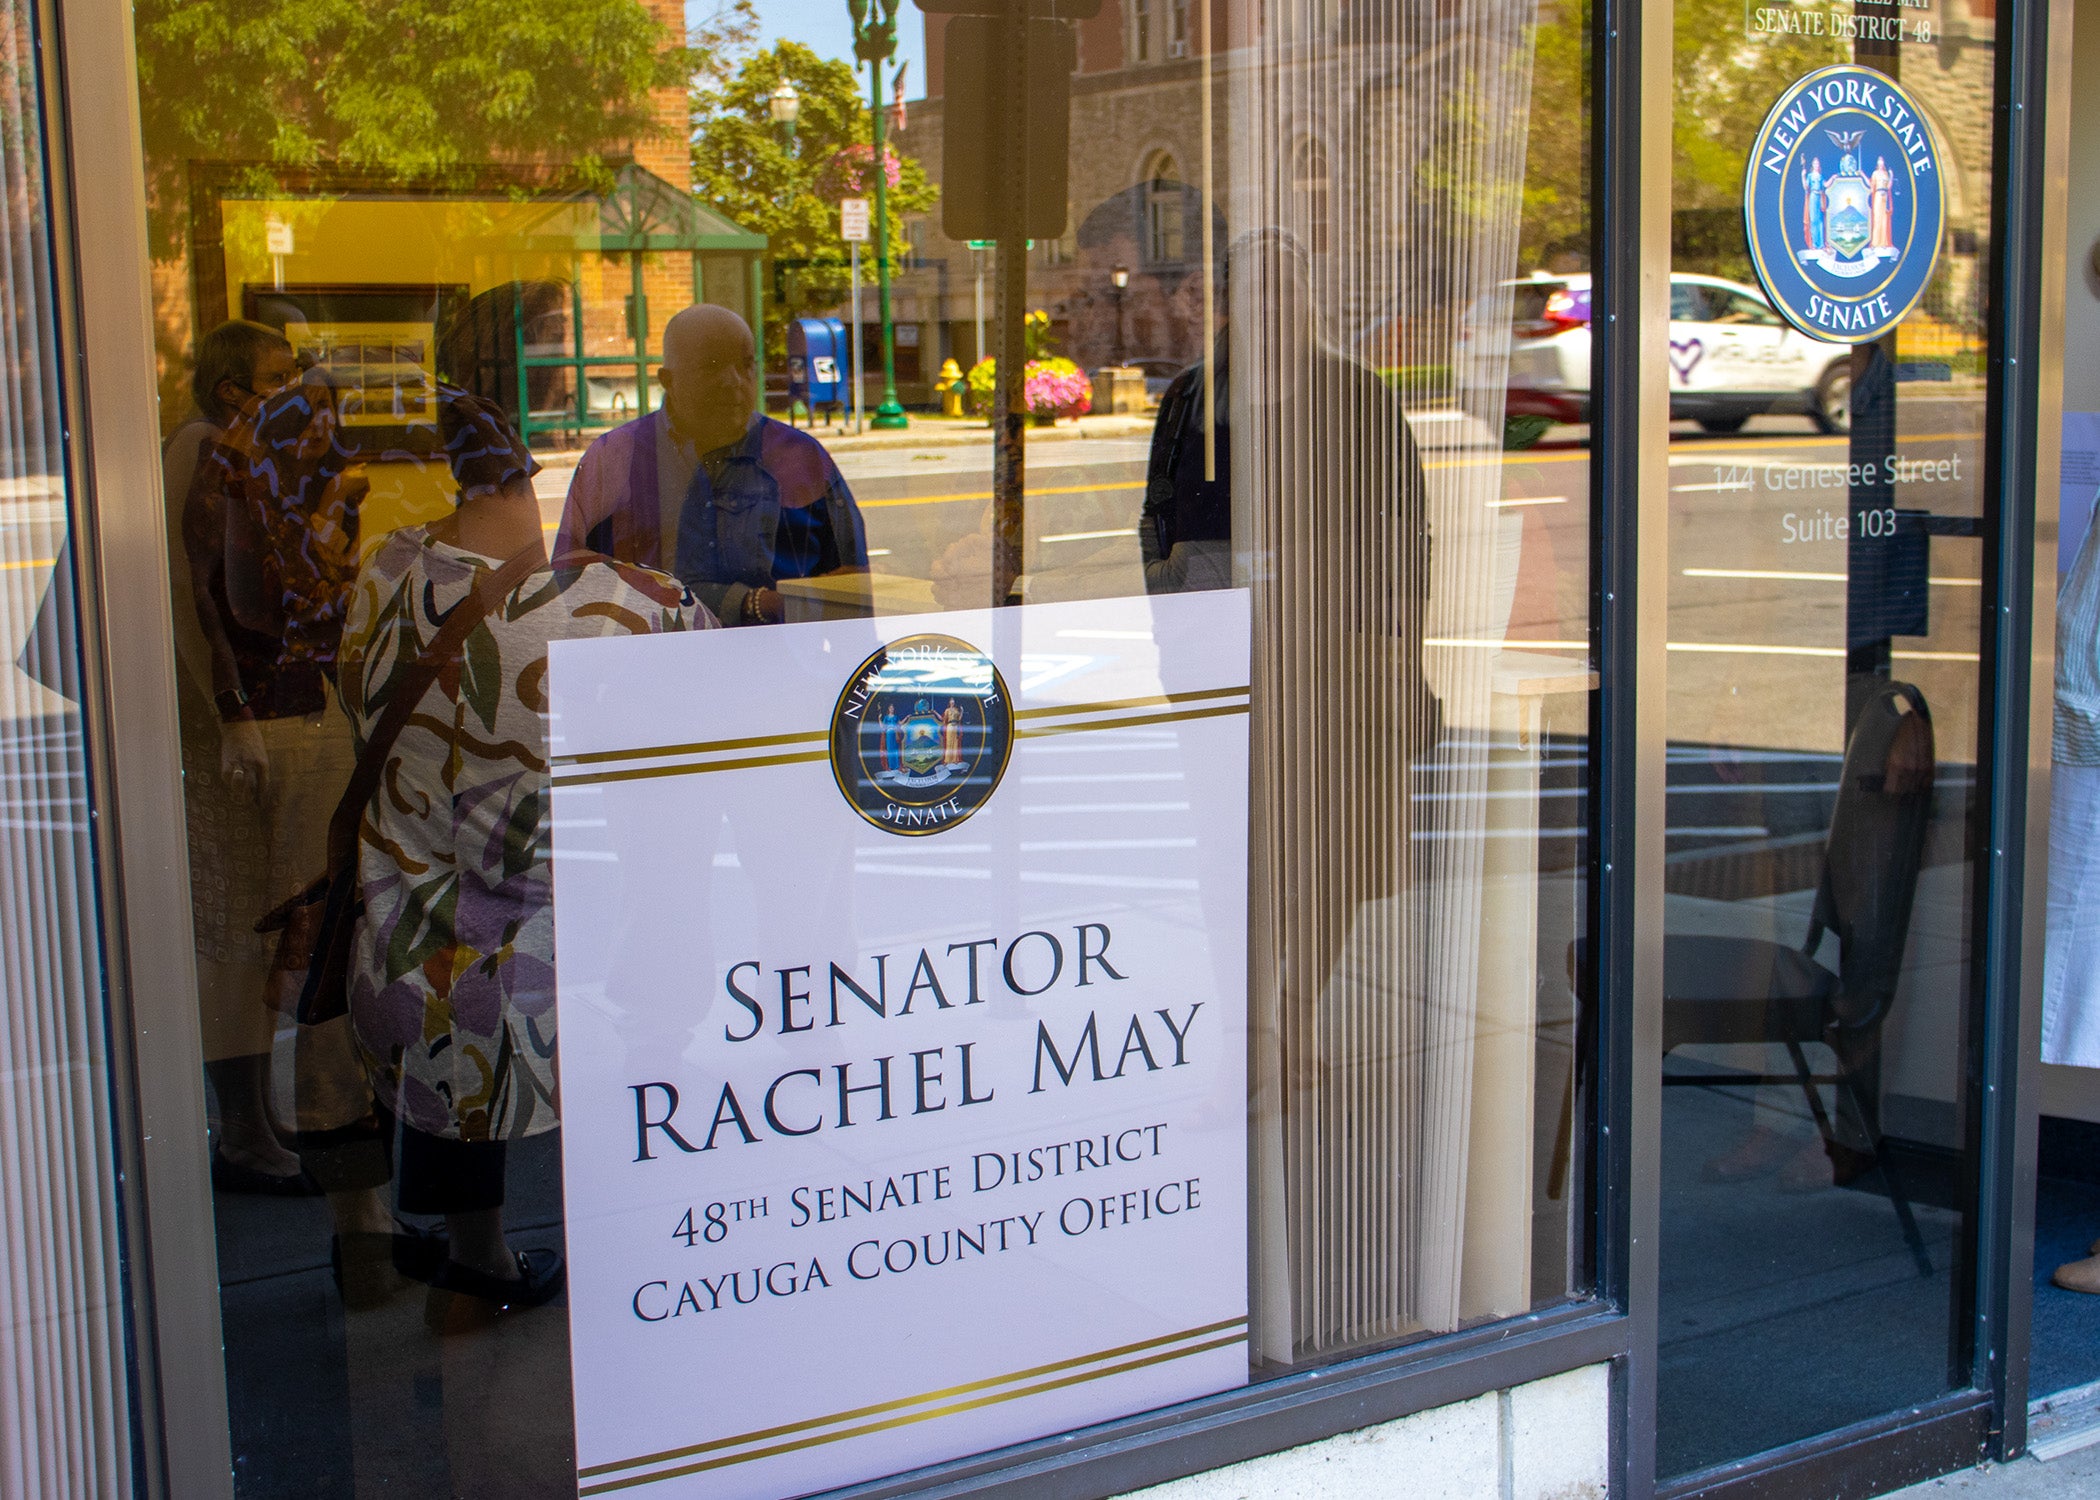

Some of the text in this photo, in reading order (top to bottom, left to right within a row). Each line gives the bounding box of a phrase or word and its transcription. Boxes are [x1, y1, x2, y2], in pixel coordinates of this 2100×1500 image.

[1755, 8, 1932, 43] SENATE DISTRICT 48
[1763, 79, 1933, 177] NEW YORK STATE
[1805, 292, 1893, 330] SENATE
[1713, 452, 1962, 494] 144 Genesee Street
[1782, 508, 1897, 544] Suite 103
[843, 664, 884, 720] NEW
[882, 796, 964, 826] SENATE
[724, 922, 1129, 1043] SENATOR
[627, 1002, 1205, 1162] RACHEL MAY
[672, 1123, 1168, 1248] 48TH SENATE DISTRICT
[632, 1178, 1202, 1322] CAYUGA COUNTY OFFICE
